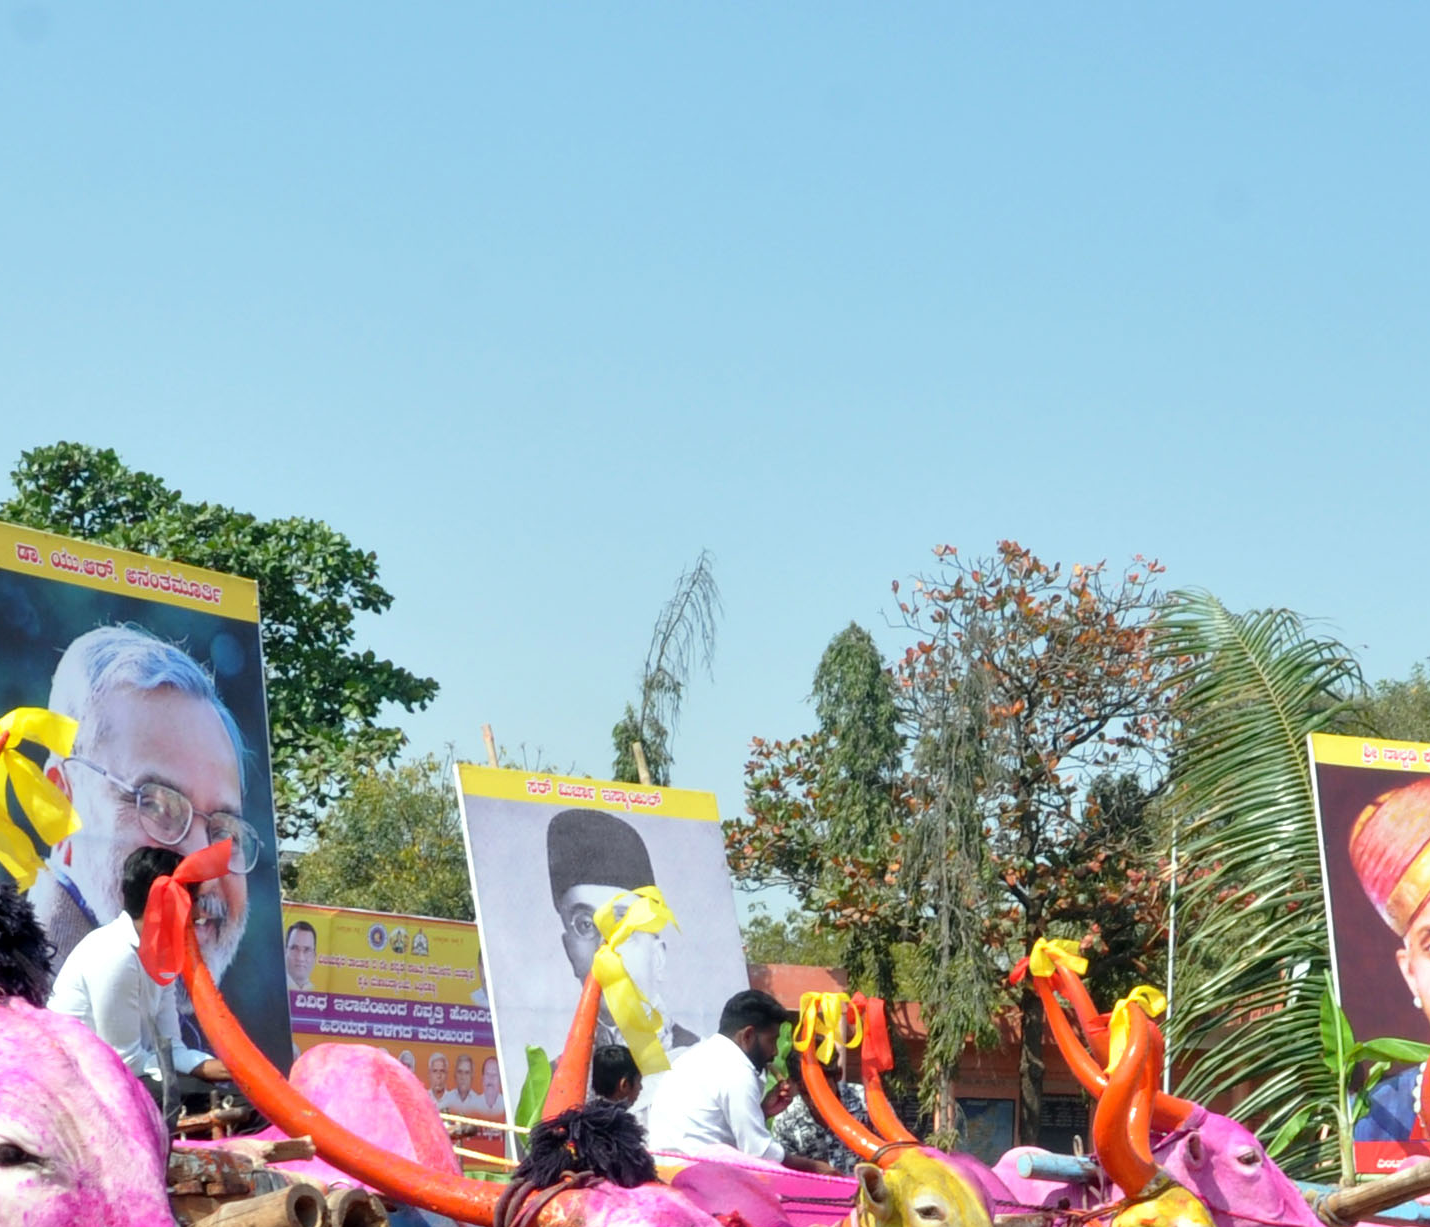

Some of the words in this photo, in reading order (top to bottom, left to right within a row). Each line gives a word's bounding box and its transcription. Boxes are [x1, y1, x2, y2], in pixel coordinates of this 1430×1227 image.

[16, 543, 43, 565] ಡಾ.
[125, 567, 222, 603] ಅನಂತಮೂರ್ತಿ
[1363, 743, 1378, 764] ಶ್ರೀ
